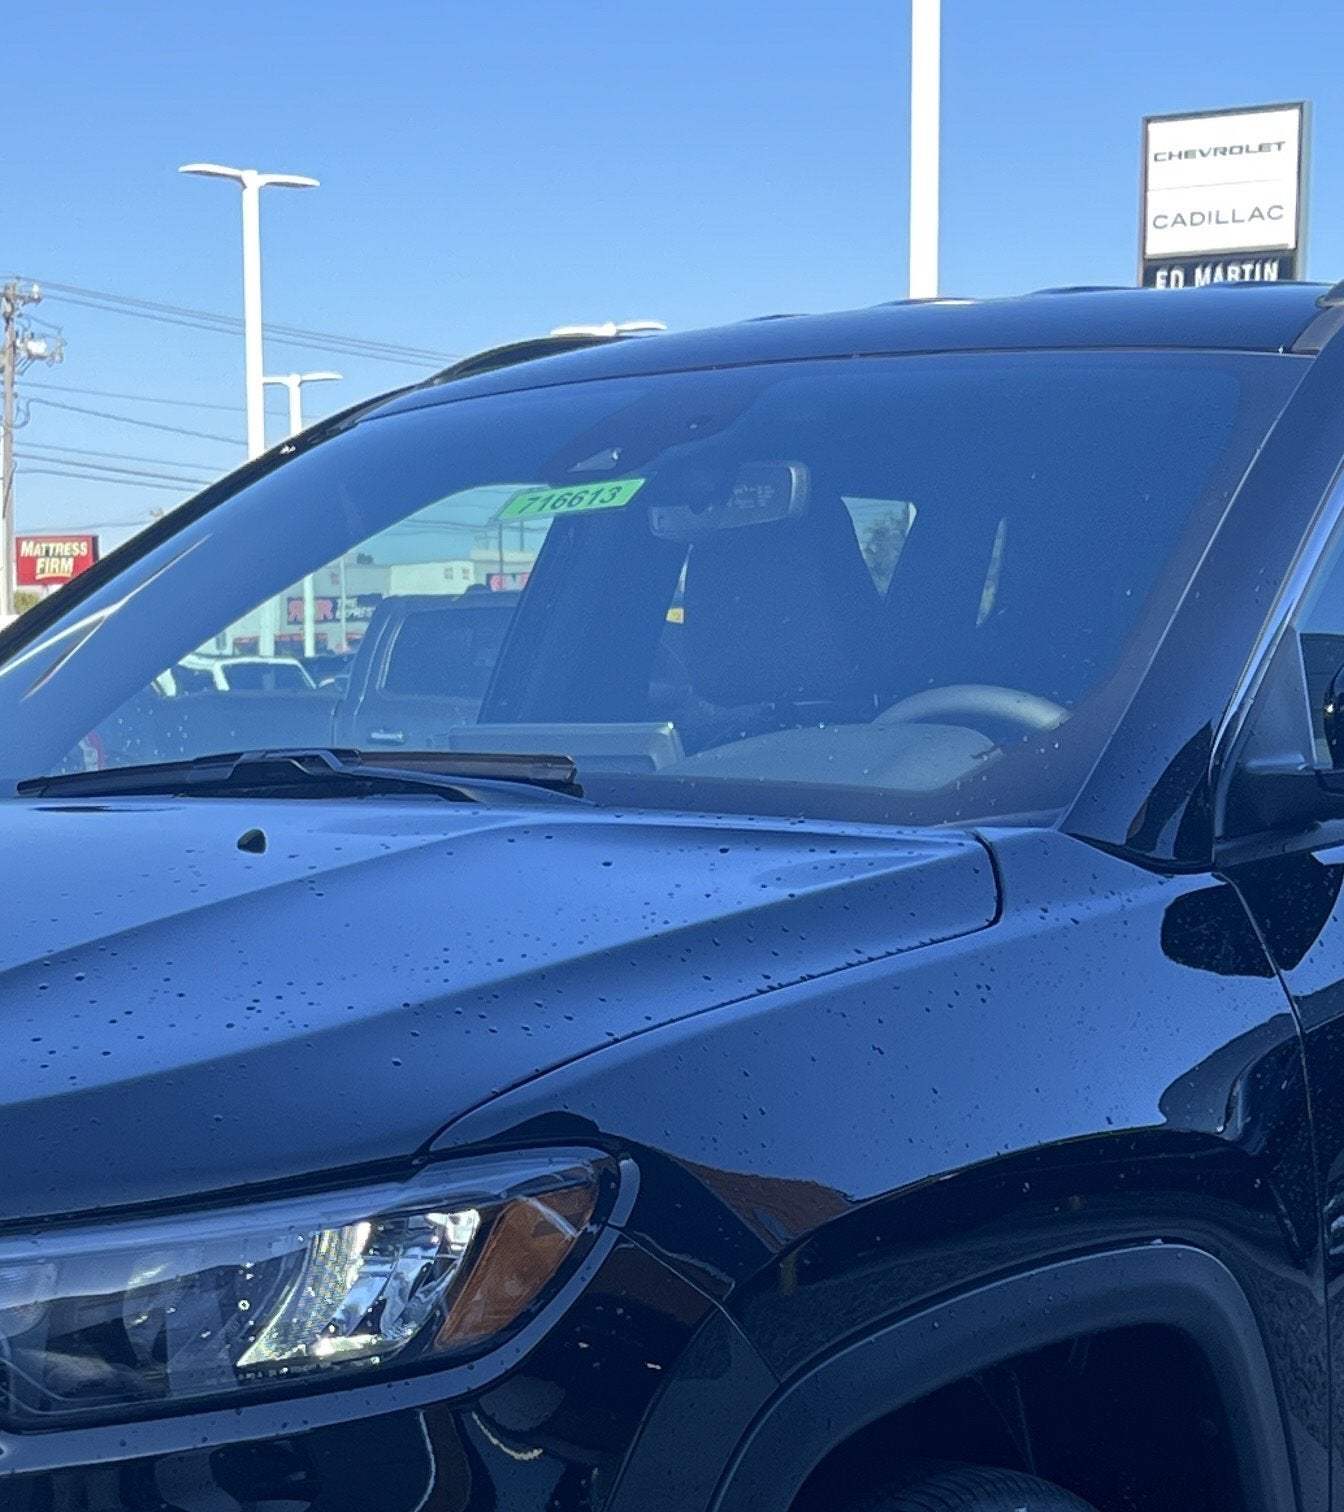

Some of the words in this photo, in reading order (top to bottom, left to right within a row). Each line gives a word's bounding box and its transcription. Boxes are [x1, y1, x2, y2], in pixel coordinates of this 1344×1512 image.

[1153, 141, 1287, 163] CHEVROLET
[1152, 204, 1285, 230] CADILLAC
[1156, 267, 1184, 289] ED
[1195, 261, 1279, 288] MARTIN
[518, 485, 623, 515] 716613
[20, 540, 88, 557] MATTRESS
[36, 557, 75, 576] FIRM
